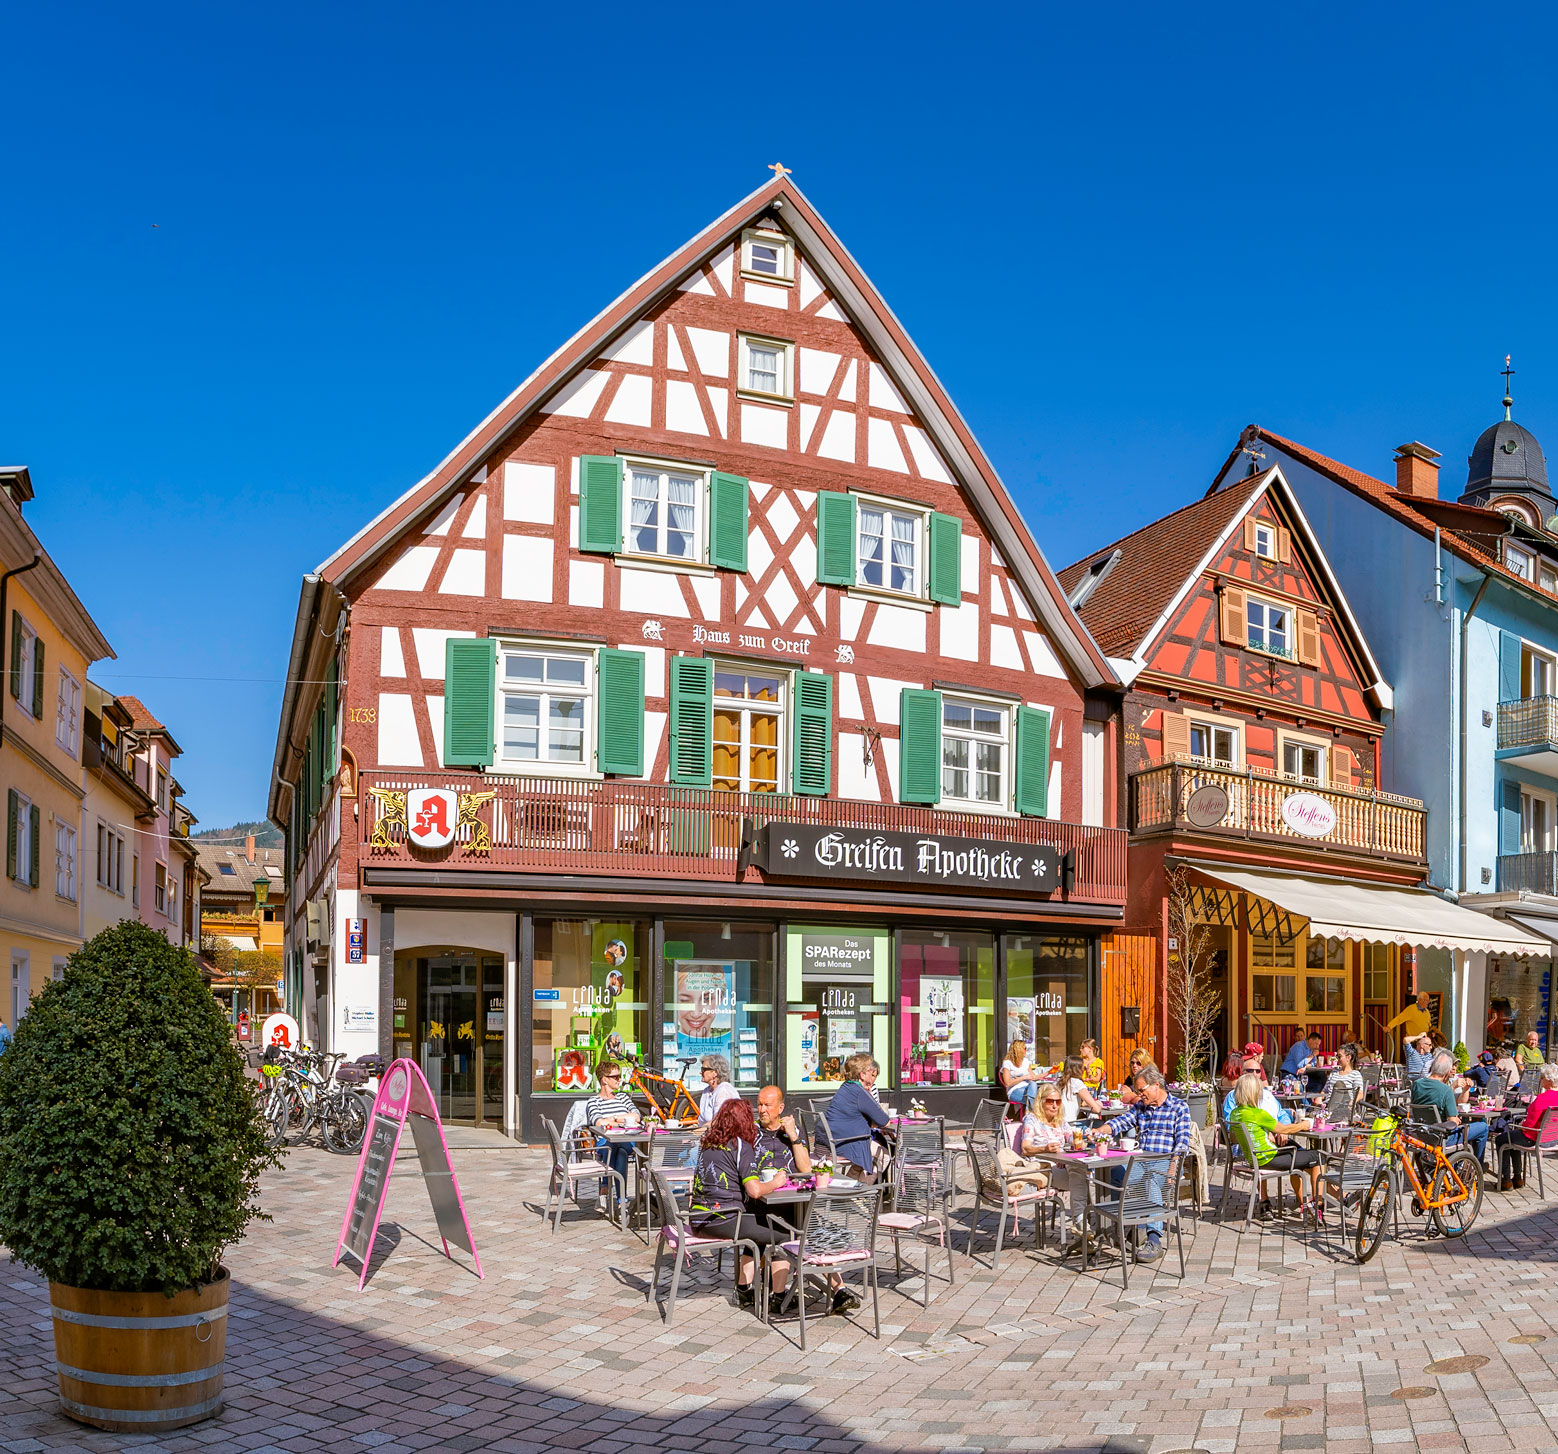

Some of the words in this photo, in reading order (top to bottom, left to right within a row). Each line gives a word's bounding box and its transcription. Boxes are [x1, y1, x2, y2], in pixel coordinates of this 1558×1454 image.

[692, 624, 731, 645] Haus
[738, 633, 766, 649] zum
[771, 636, 811, 655] Greif
[349, 707, 377, 724] 1738
[1287, 799, 1331, 826] Steffens
[814, 831, 905, 874] Greifen
[915, 837, 1024, 882] Apotheke
[844, 939, 859, 948] Das
[805, 945, 871, 962] SPARezept
[814, 960, 826, 968] des
[827, 960, 852, 968] Monats
[701, 1007, 737, 1016] Apotheken
[822, 1008, 855, 1017] Apotheken
